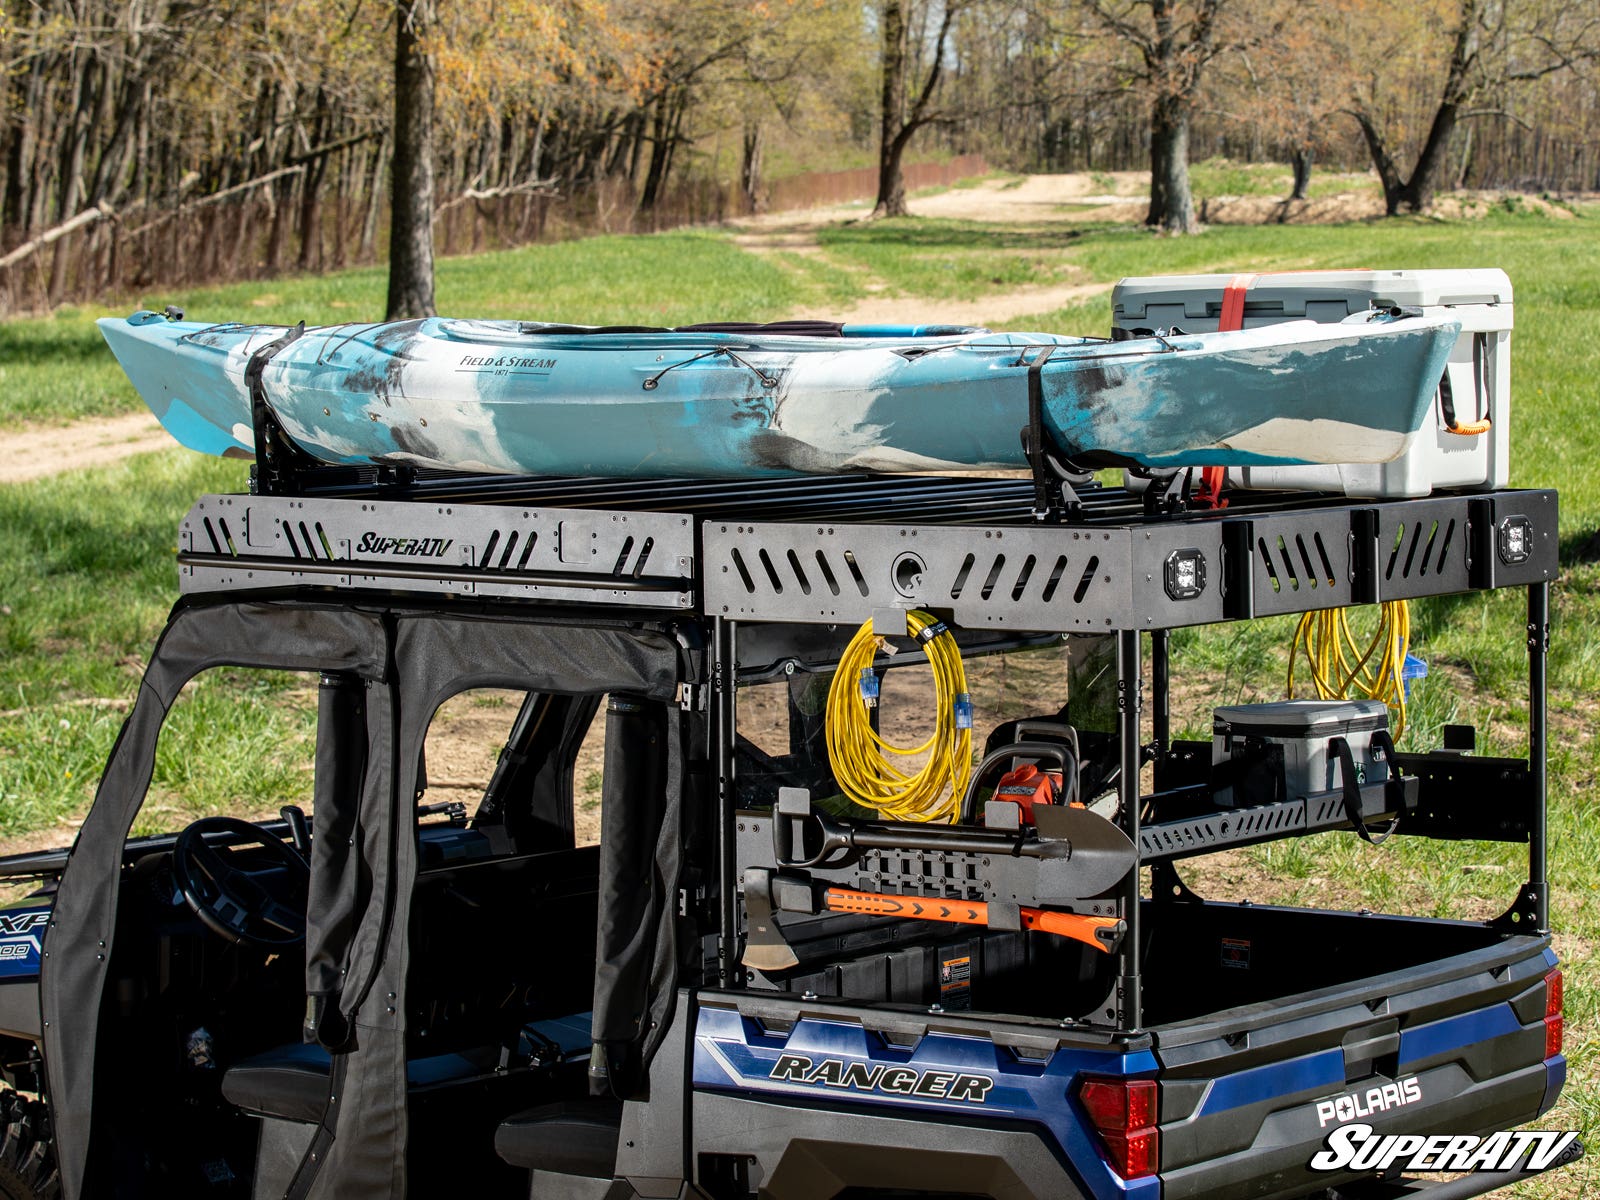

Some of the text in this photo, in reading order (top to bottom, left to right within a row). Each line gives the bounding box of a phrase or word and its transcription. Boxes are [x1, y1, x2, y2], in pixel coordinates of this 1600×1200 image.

[460, 355, 558, 369] FIELD & STREAM
[0, 944, 30, 956] 00
[769, 1053, 995, 1102] RANGER
[1316, 1077, 1422, 1127] POLARIS
